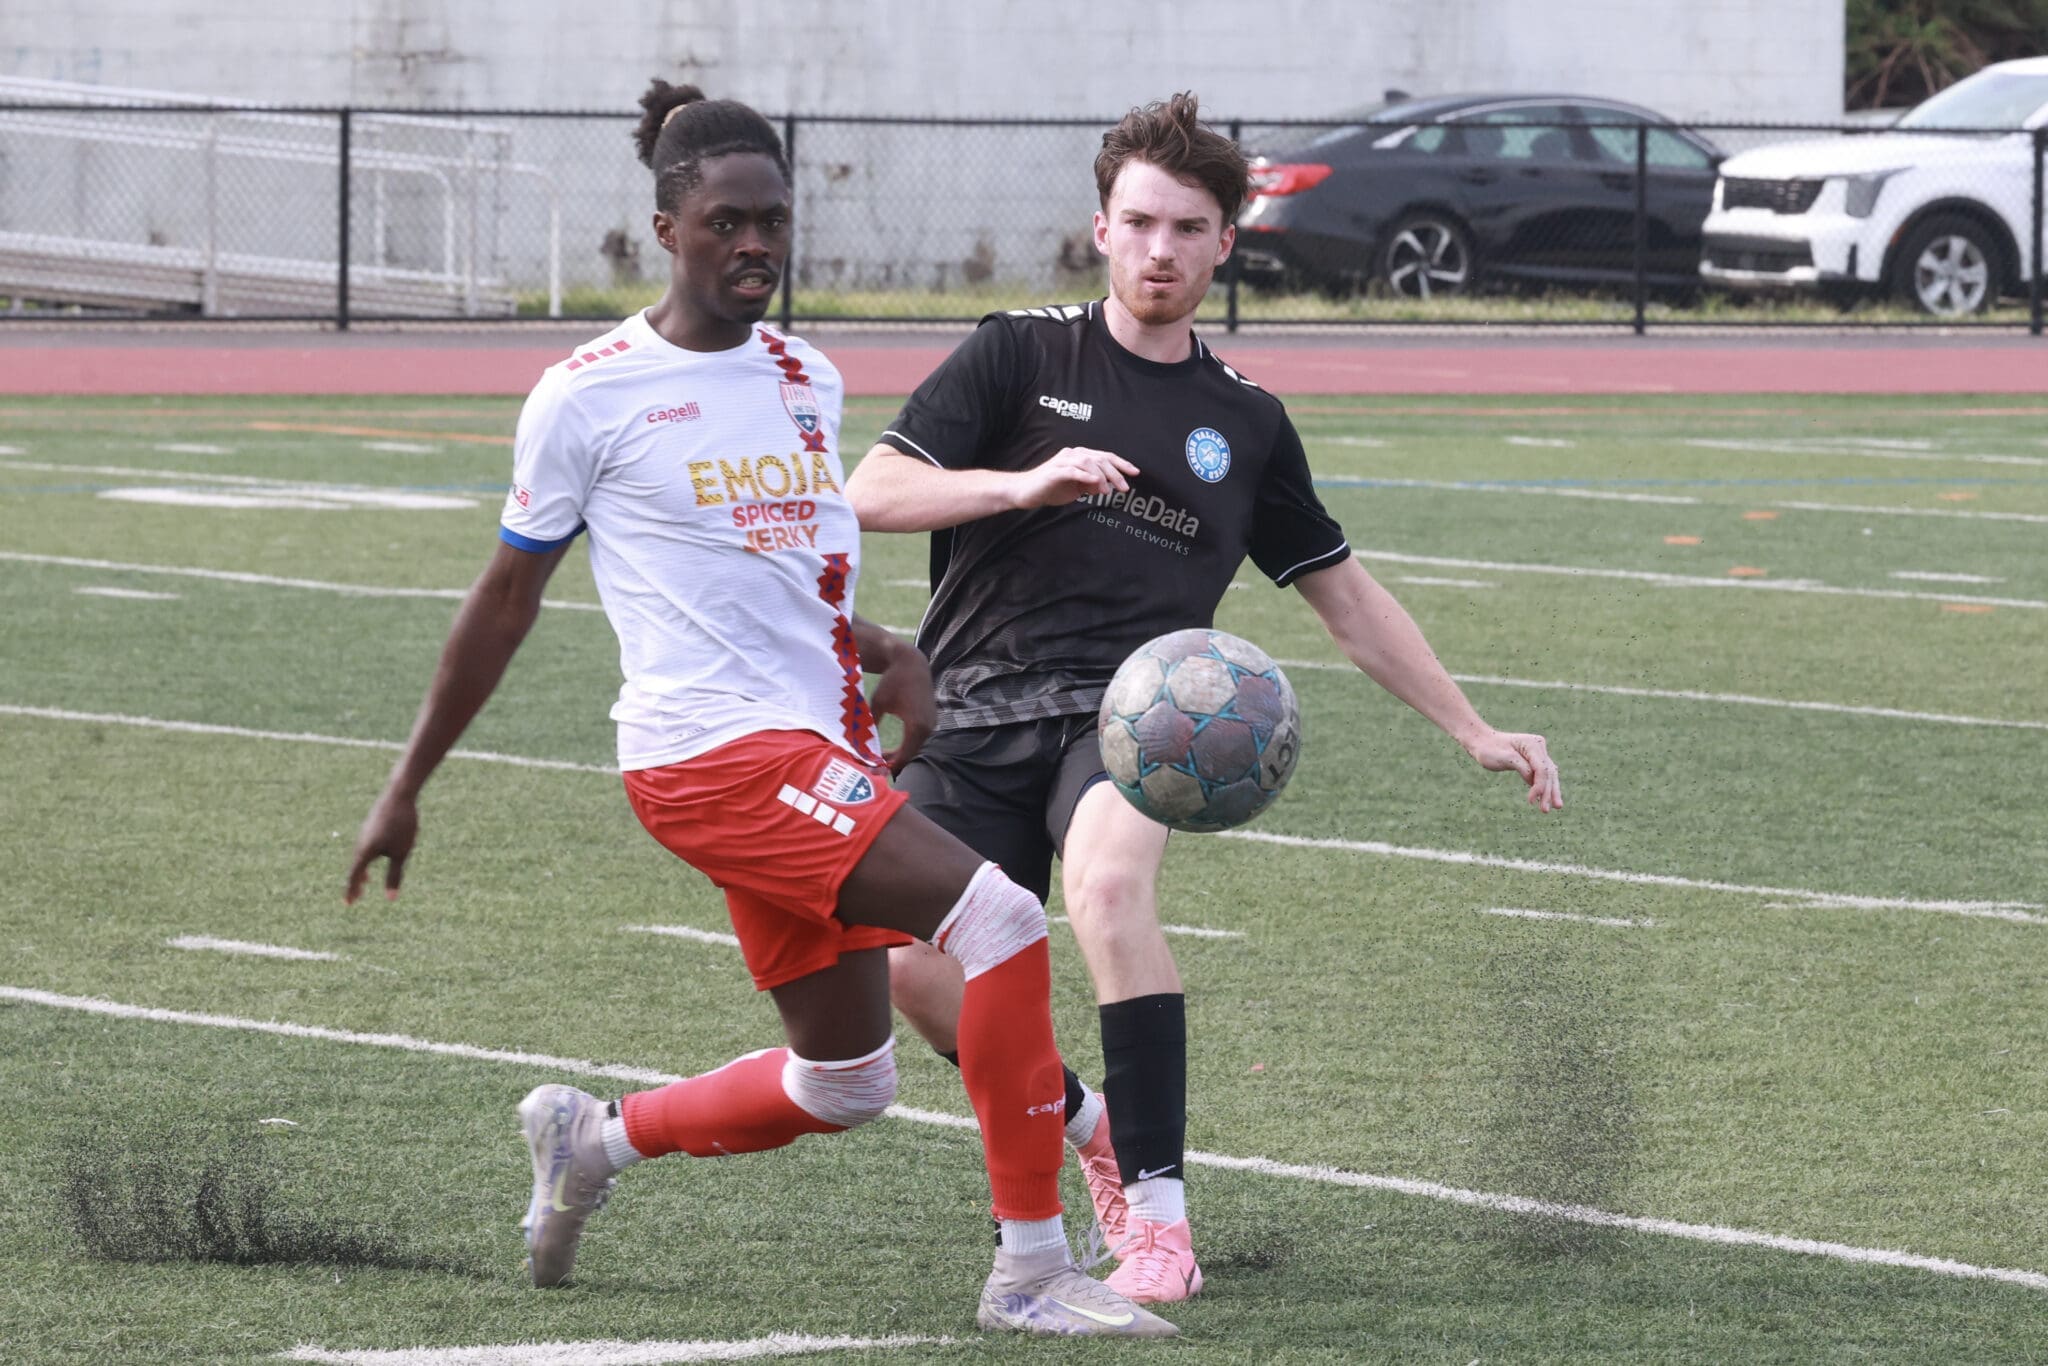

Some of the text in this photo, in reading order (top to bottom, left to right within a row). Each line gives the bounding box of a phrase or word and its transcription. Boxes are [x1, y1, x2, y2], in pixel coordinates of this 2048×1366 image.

[647, 401, 701, 423] capelli
[1039, 395, 1092, 418] capelli
[1061, 410, 1091, 422] SPORT
[1194, 431, 1226, 449] VALLEY
[689, 452, 841, 506] EMOJA
[1208, 452, 1228, 480] UNITED
[732, 500, 816, 528] SPICED
[743, 524, 820, 553] JERKY
[1125, 524, 1190, 556] networks
